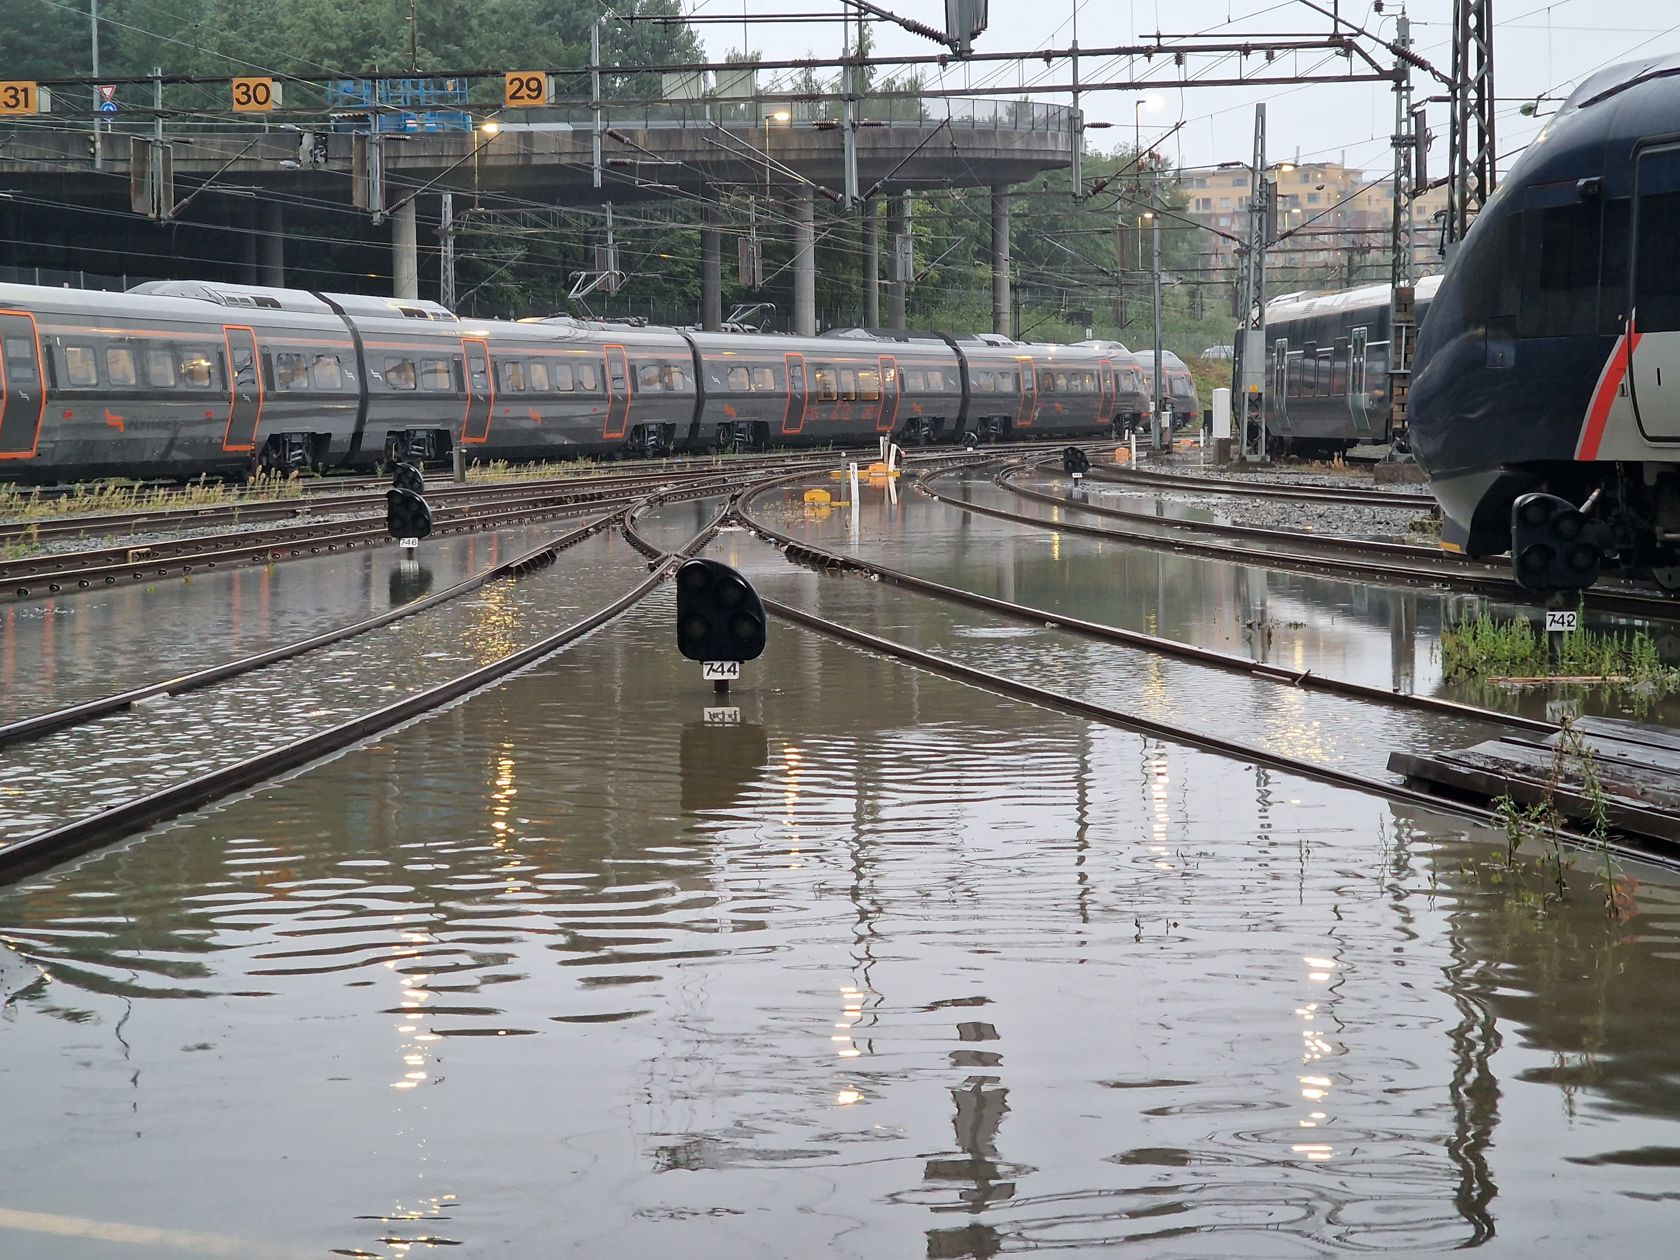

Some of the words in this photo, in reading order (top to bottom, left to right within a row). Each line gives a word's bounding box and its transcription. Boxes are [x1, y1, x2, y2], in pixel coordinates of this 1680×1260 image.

[3, 86, 29, 109] 31
[235, 82, 271, 106] 30
[509, 77, 543, 100] 29
[400, 538, 417, 546] 746
[1547, 613, 1576, 628] 742
[704, 662, 738, 676] 744
